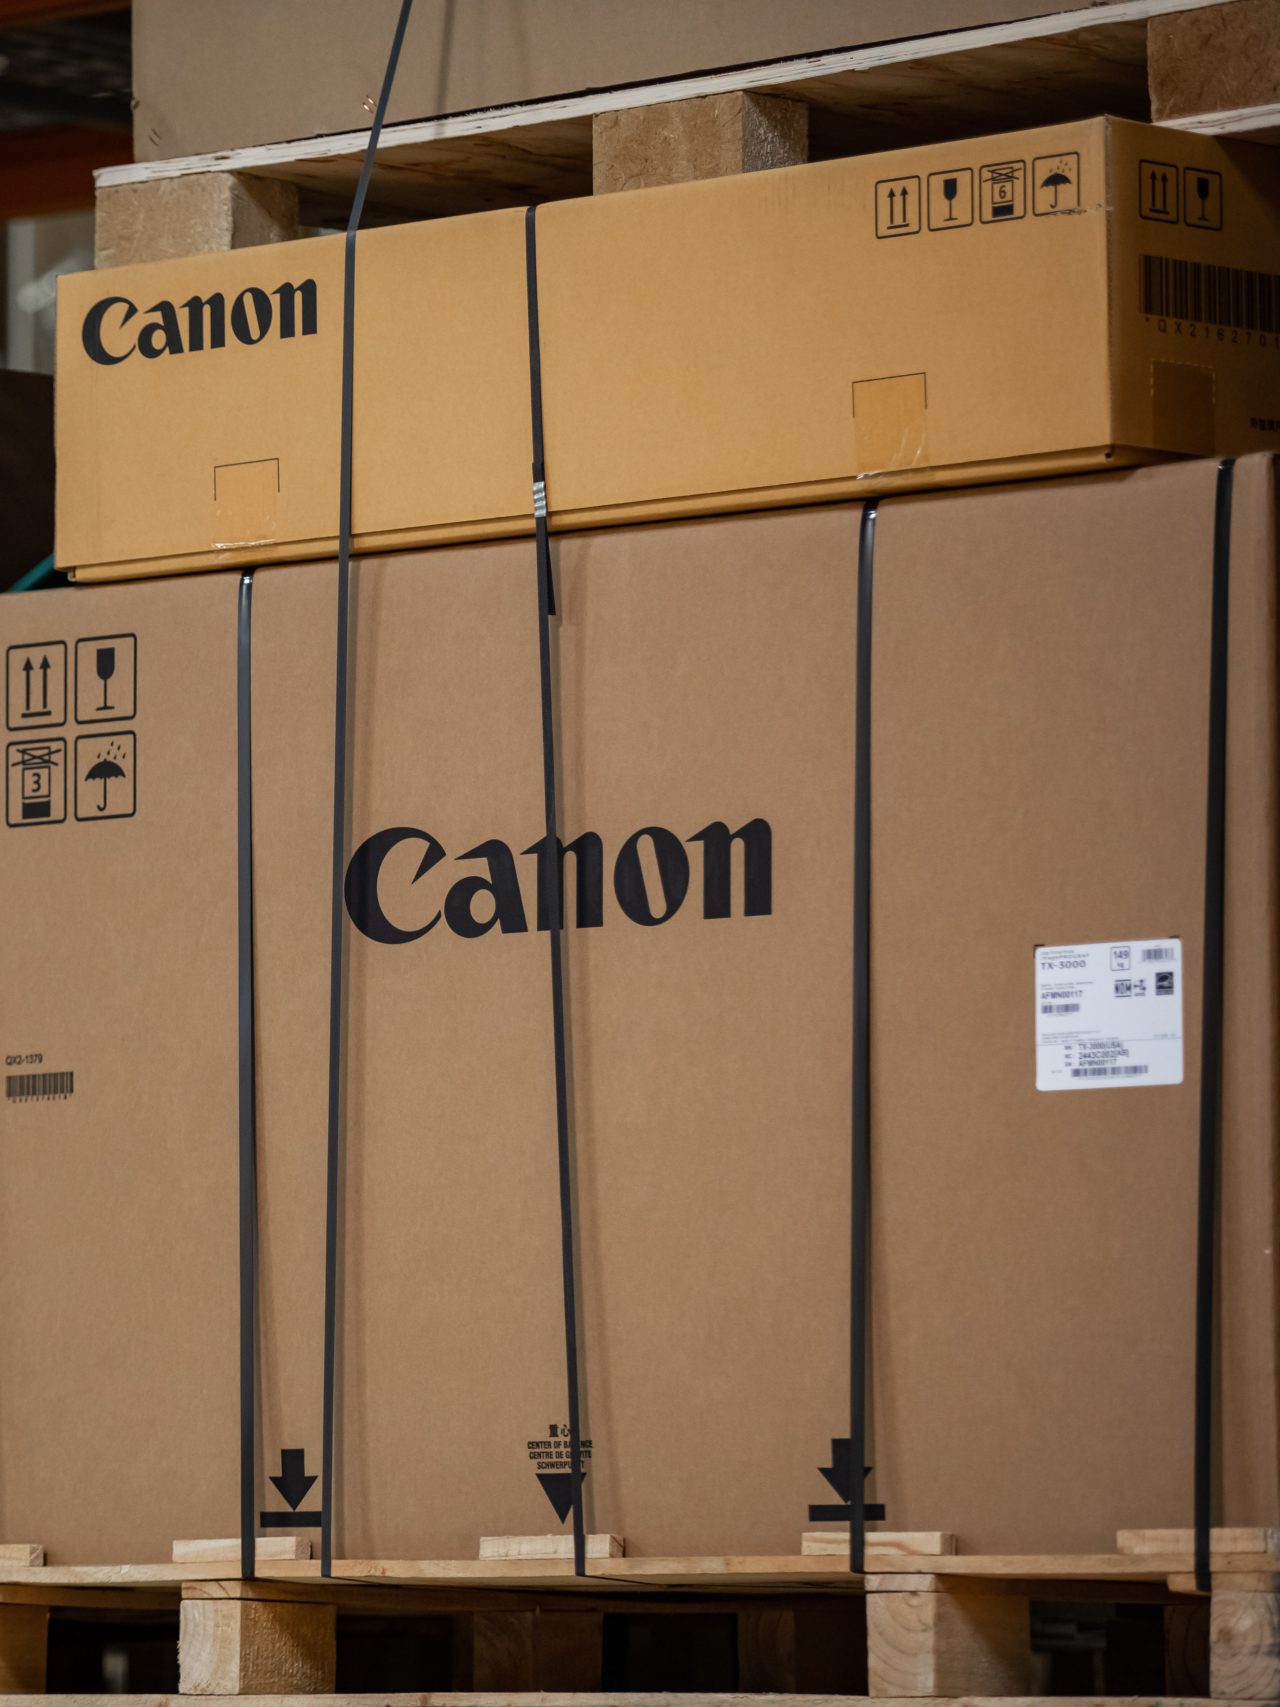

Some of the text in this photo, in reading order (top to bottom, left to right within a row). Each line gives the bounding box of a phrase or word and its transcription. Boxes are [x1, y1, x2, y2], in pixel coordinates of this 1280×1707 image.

[81, 278, 318, 366] Canon
[343, 817, 772, 945] Canon
[1040, 960, 1087, 971] TX-3000
[527, 1440, 593, 1450] CENTER OF BNCE
[529, 1450, 592, 1460] CENTRE DE GVITE
[536, 1461, 585, 1470] SCHWERPUT
